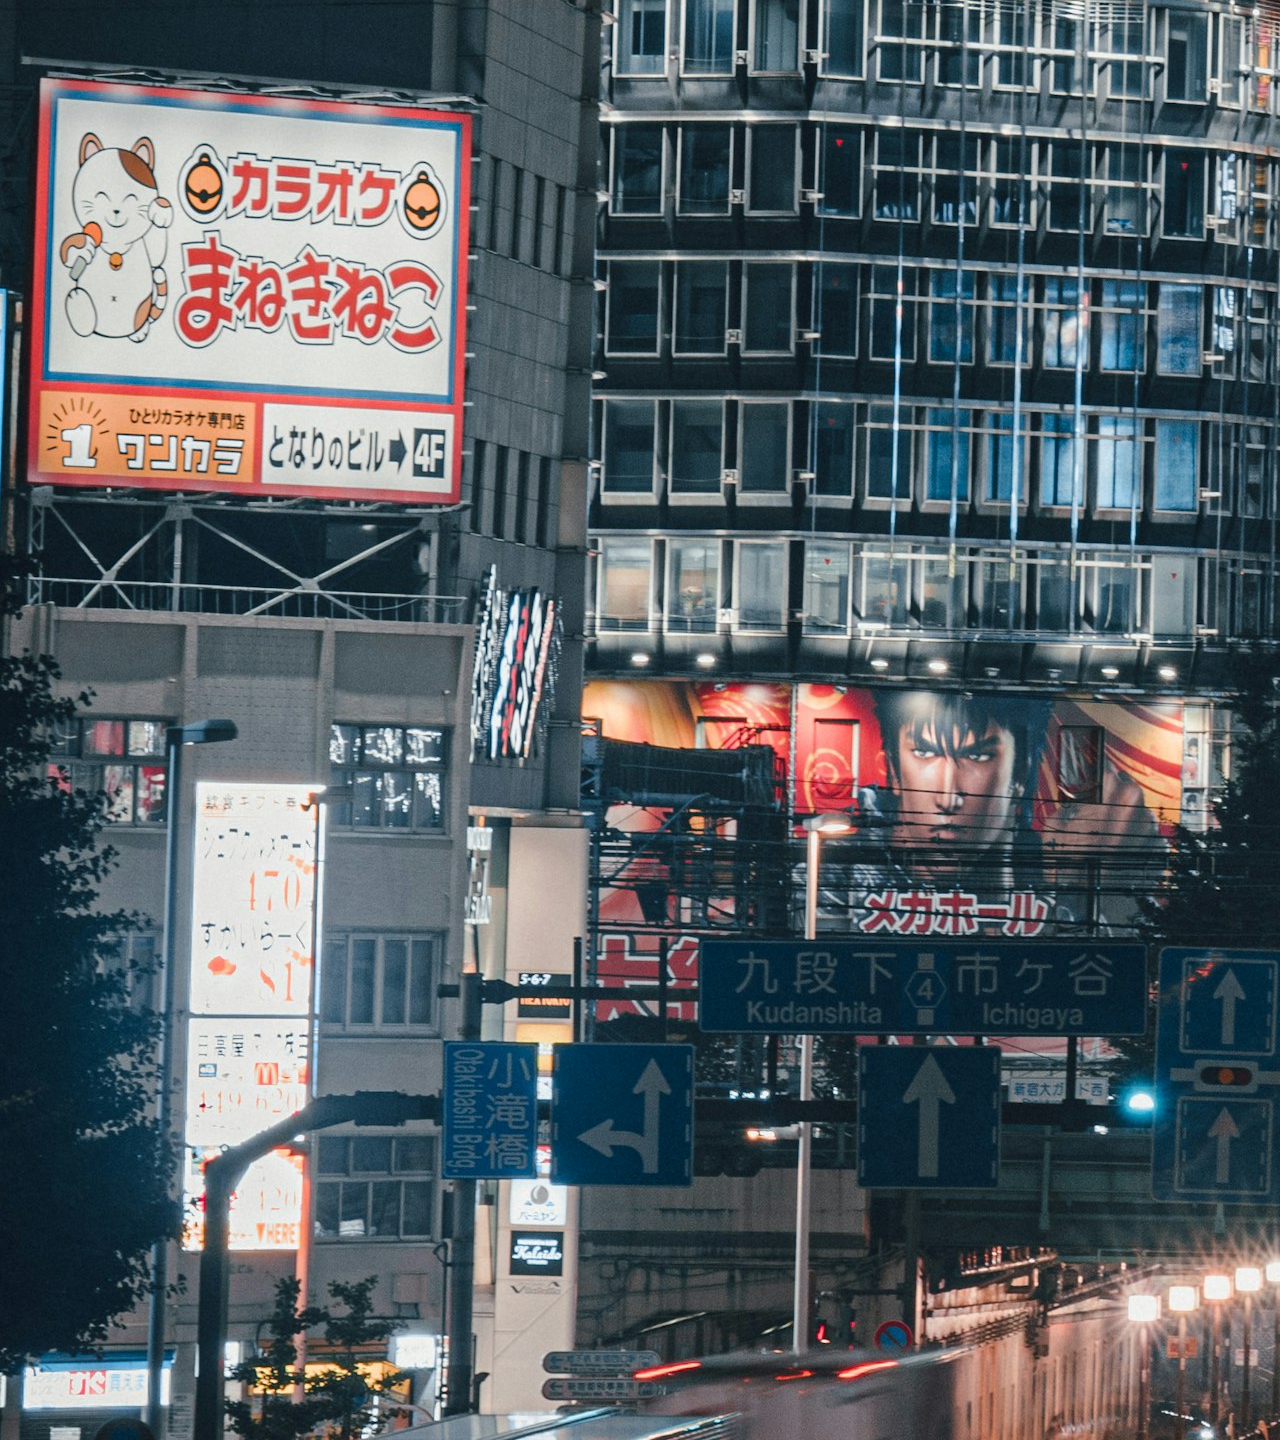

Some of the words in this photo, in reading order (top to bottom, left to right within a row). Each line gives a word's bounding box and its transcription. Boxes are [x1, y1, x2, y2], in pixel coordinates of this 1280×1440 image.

[231, 158, 401, 222] カラオケ
[177, 234, 442, 350] まねきねこ
[129, 407, 246, 431] ひとりカラオケ専門店
[116, 432, 245, 476] ワンカラ
[267, 424, 386, 474] となりのビル
[413, 431, 445, 475] 4F
[859, 889, 1049, 937] メガホール
[735, 950, 898, 996] 九段下
[915, 977, 934, 1002] 4
[747, 1000, 882, 1025] Kudanshita
[983, 1002, 1083, 1031] Ichigaya
[451, 1049, 484, 1131] Otakibashi
[483, 1051, 534, 1172] 小滝橋
[1012, 1081, 1104, 1099] 新宿大ガド西
[452, 1133, 474, 1173] Brdg.
[517, 1210, 559, 1223] バーミヤン
